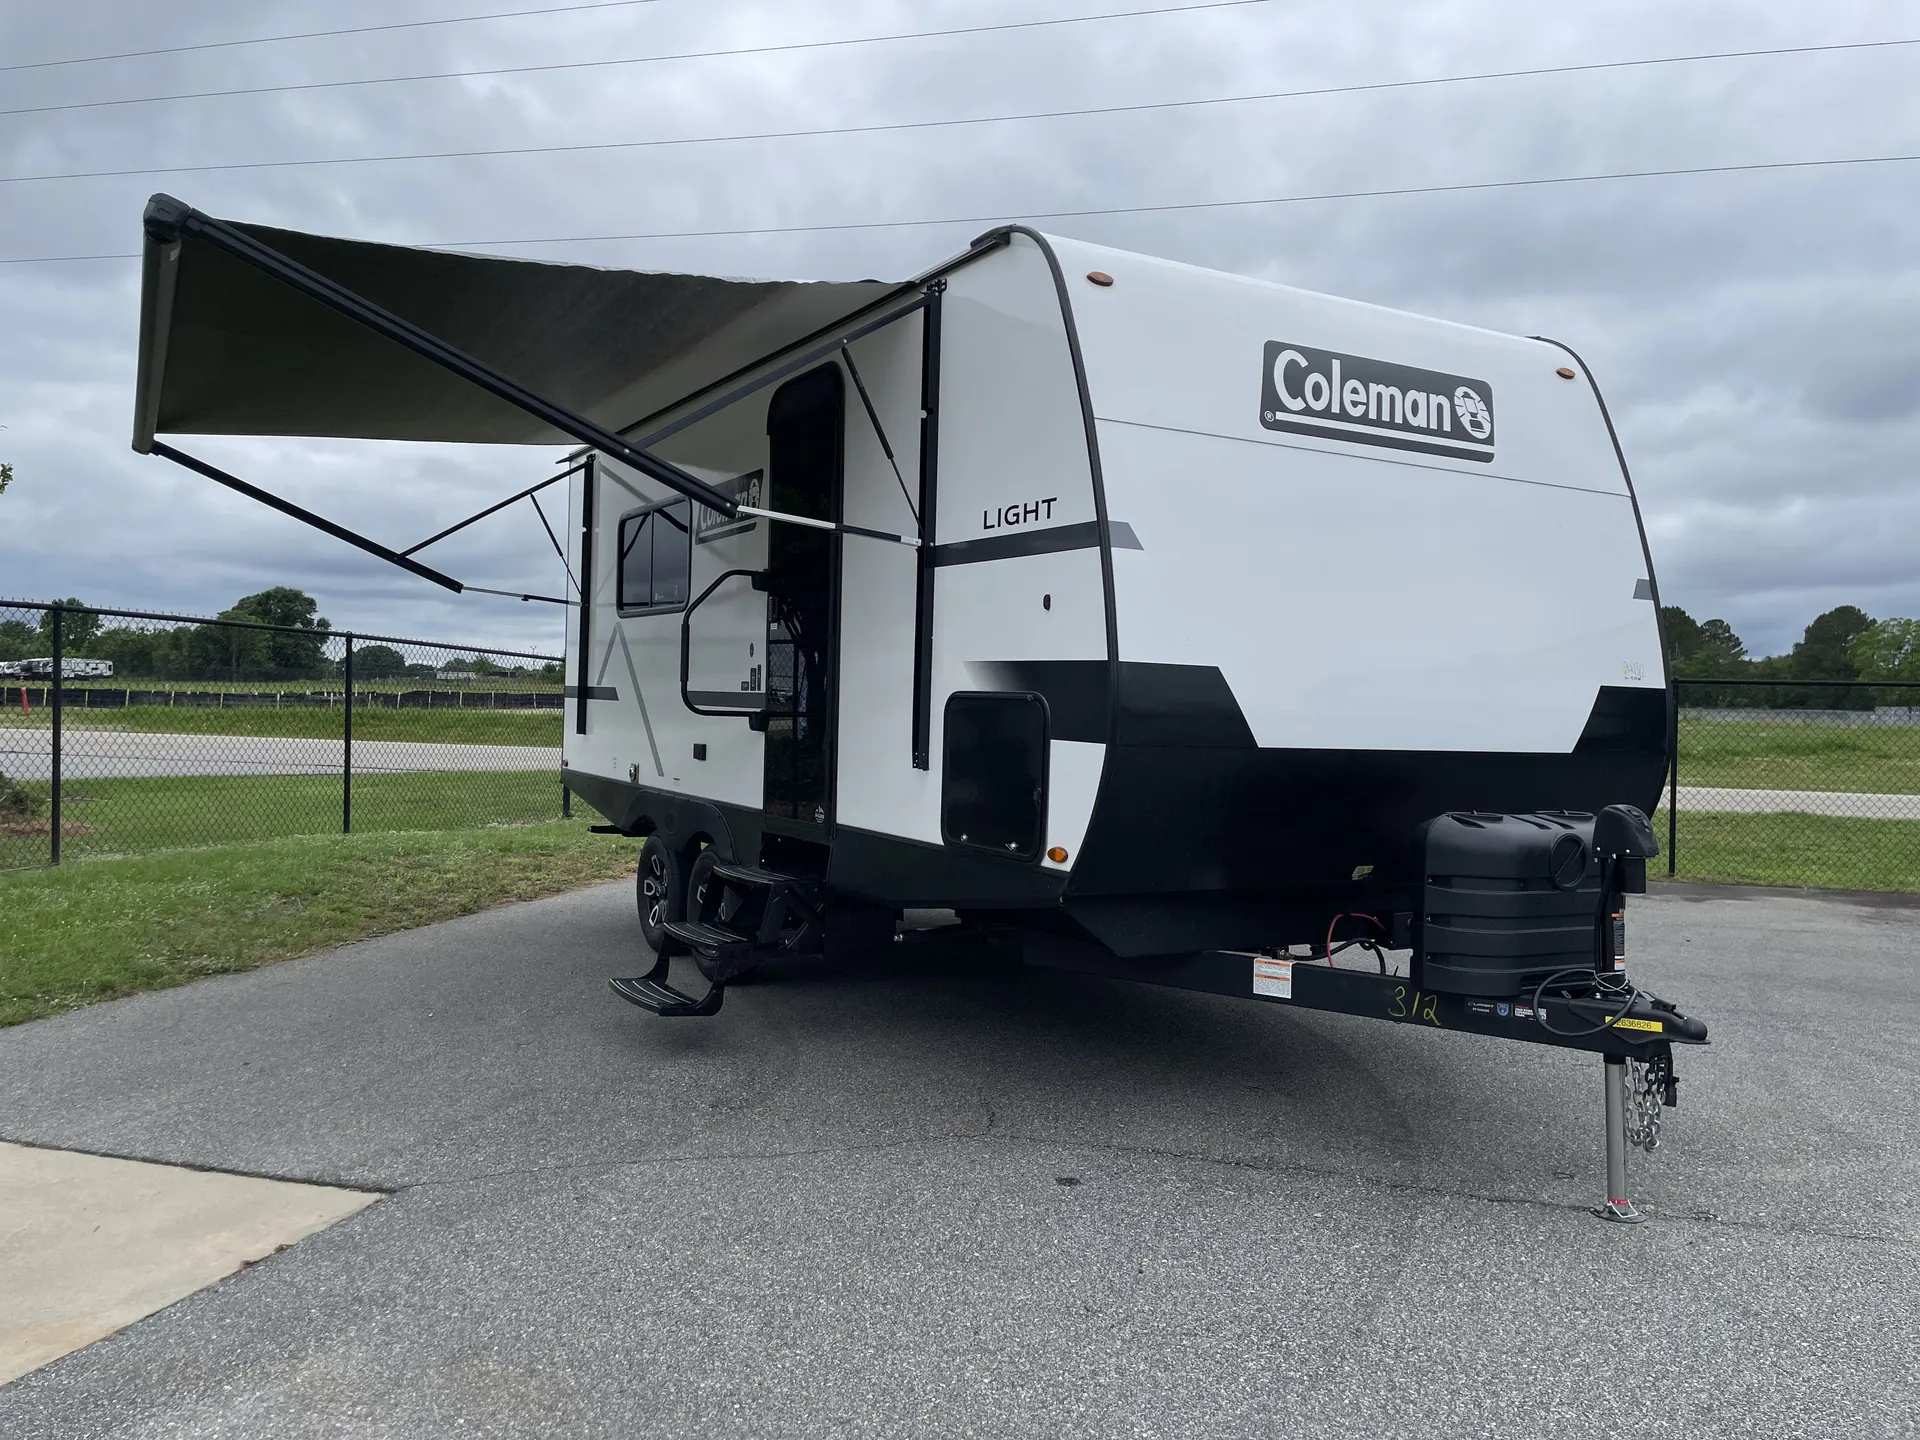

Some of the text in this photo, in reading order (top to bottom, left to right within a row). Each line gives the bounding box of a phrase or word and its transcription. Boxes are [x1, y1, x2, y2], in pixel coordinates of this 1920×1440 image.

[1274, 349, 1451, 432] Coleman
[983, 497, 1057, 530] LIGHT
[1388, 986, 1441, 1025] 312
